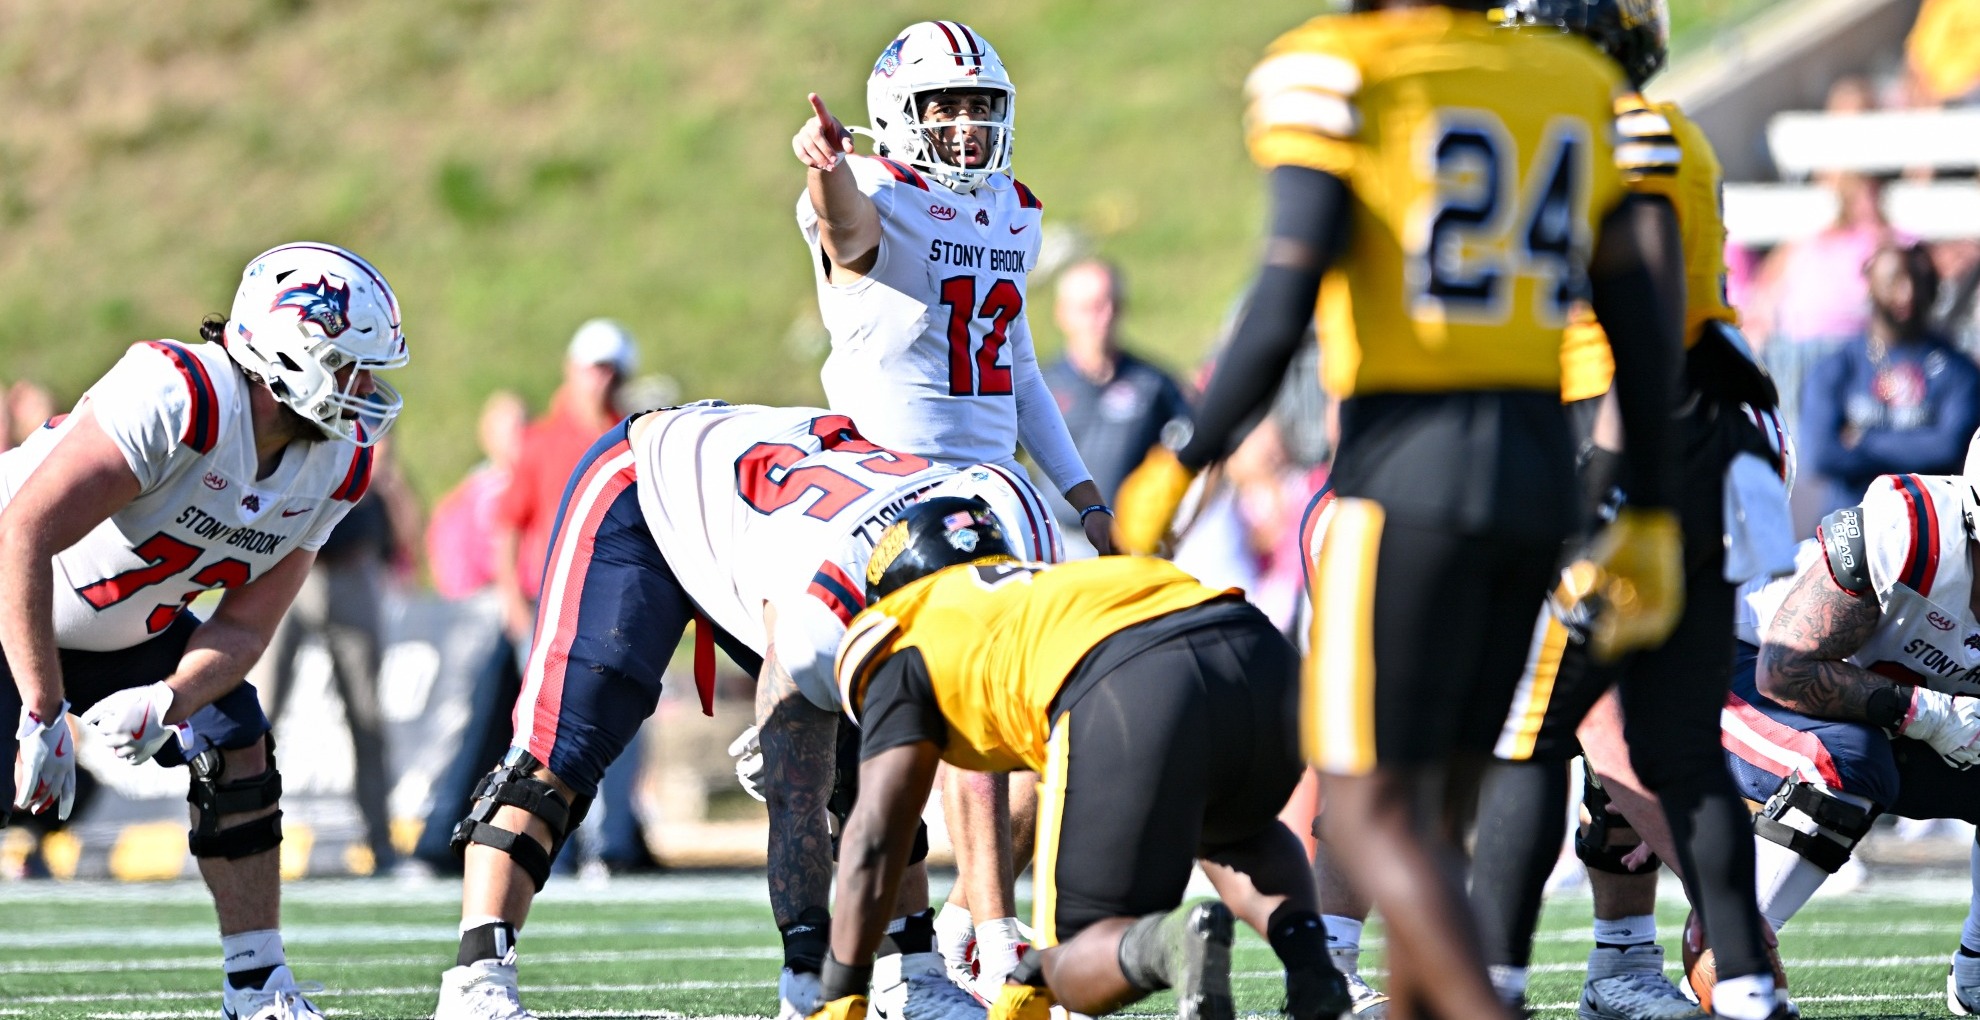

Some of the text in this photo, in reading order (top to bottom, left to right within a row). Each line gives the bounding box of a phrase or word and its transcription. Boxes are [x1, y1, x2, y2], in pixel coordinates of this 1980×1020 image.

[929, 204, 953, 218] CAA
[1414, 115, 1588, 323] 24
[929, 238, 1026, 273] STONY BROOK
[939, 274, 1023, 397] 12
[204, 471, 225, 488] CAA
[175, 505, 287, 555] STONY BROOK
[1841, 510, 1861, 539] PRO
[1831, 522, 1855, 571] GEAR
[1927, 611, 1951, 629] CAA
[1903, 638, 1967, 678] STONY
